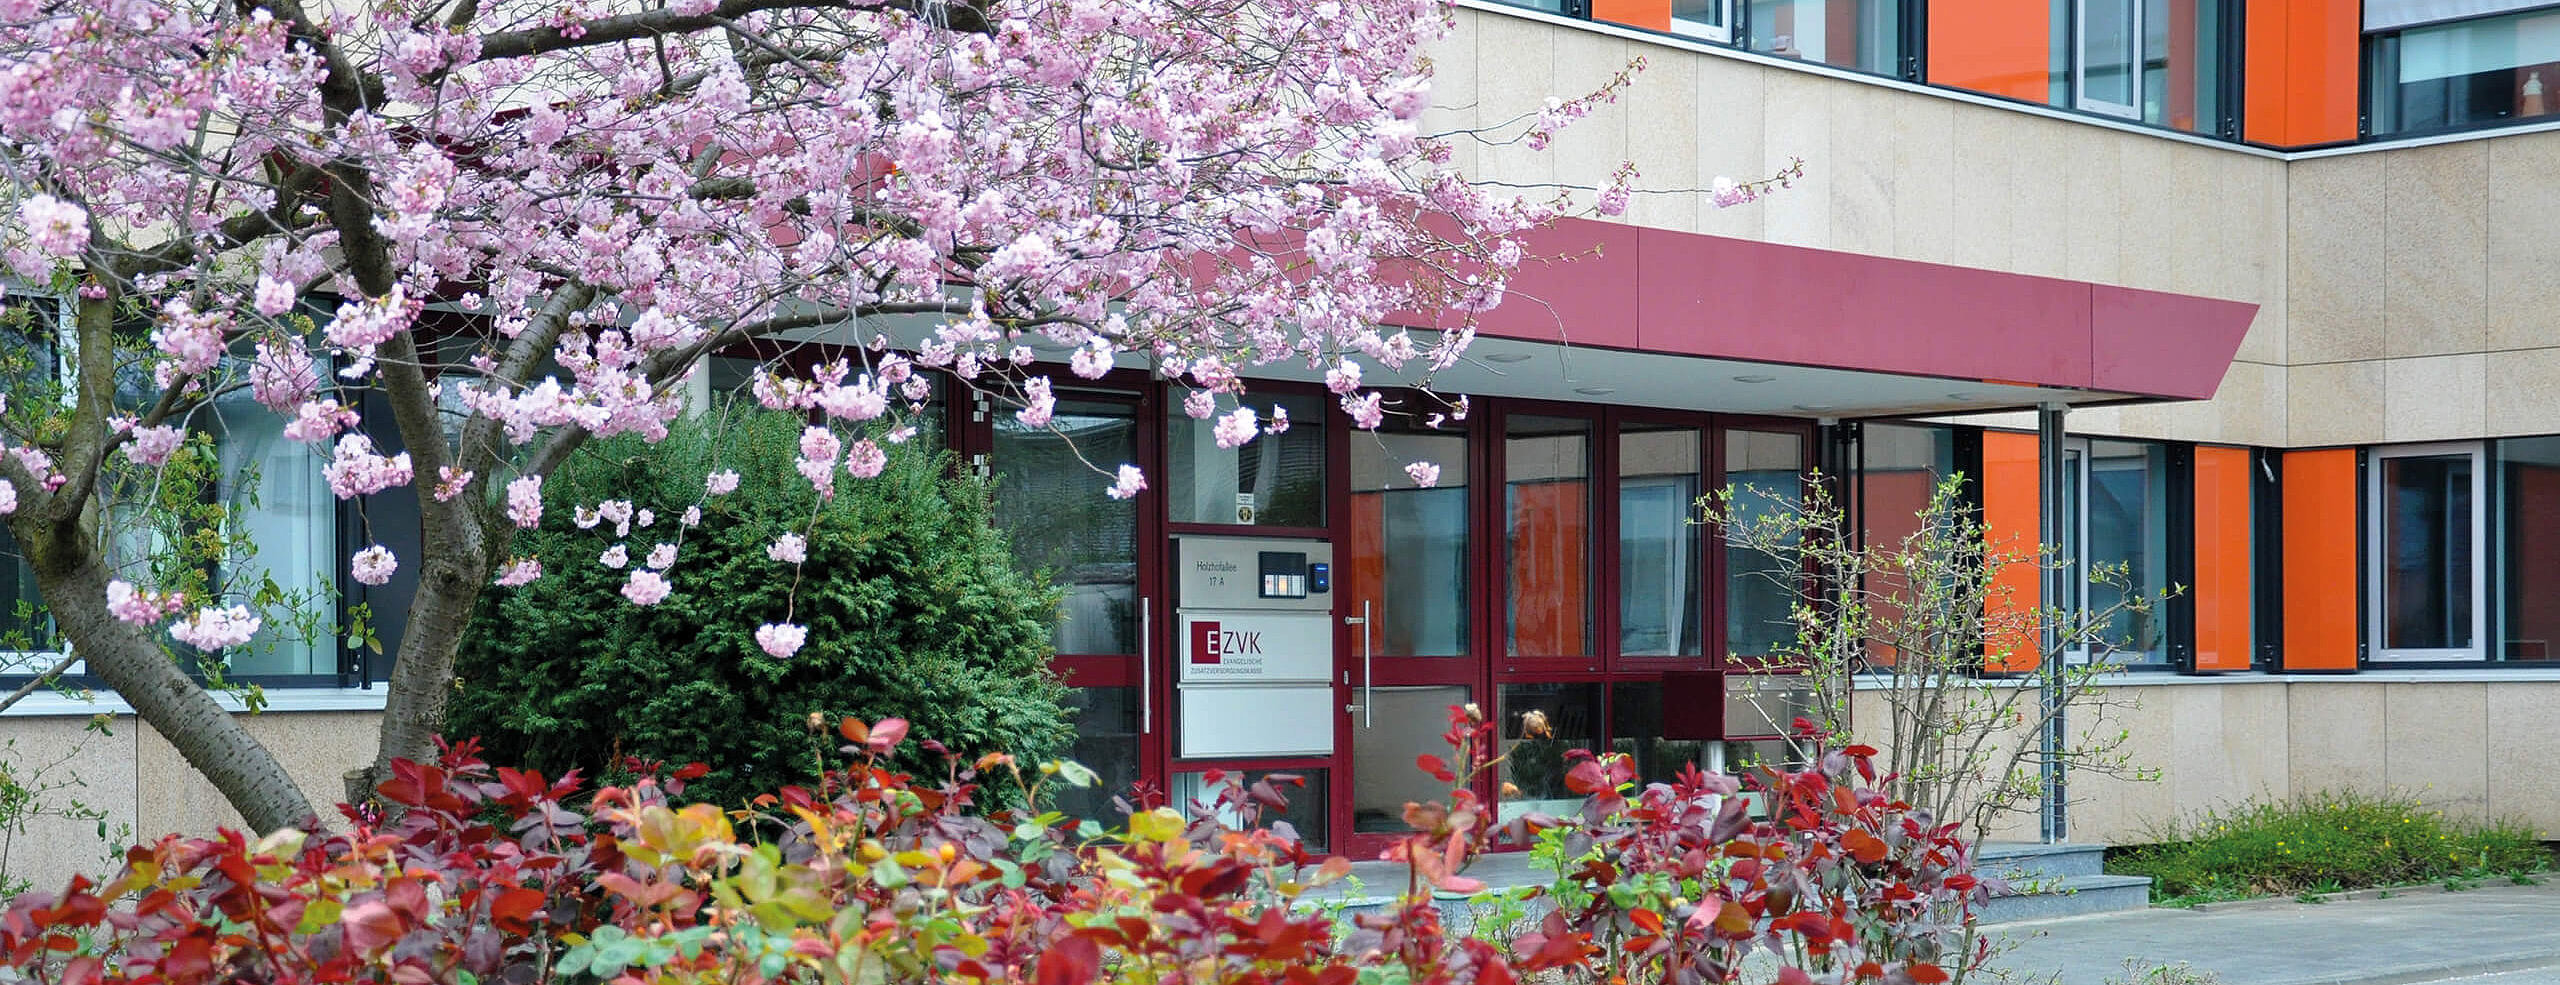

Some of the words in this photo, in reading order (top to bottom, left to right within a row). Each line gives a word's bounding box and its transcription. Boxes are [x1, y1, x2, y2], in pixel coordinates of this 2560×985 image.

[1209, 577, 1217, 586] 17
[1219, 577, 1225, 586] A
[1207, 630, 1261, 654] EZVK
